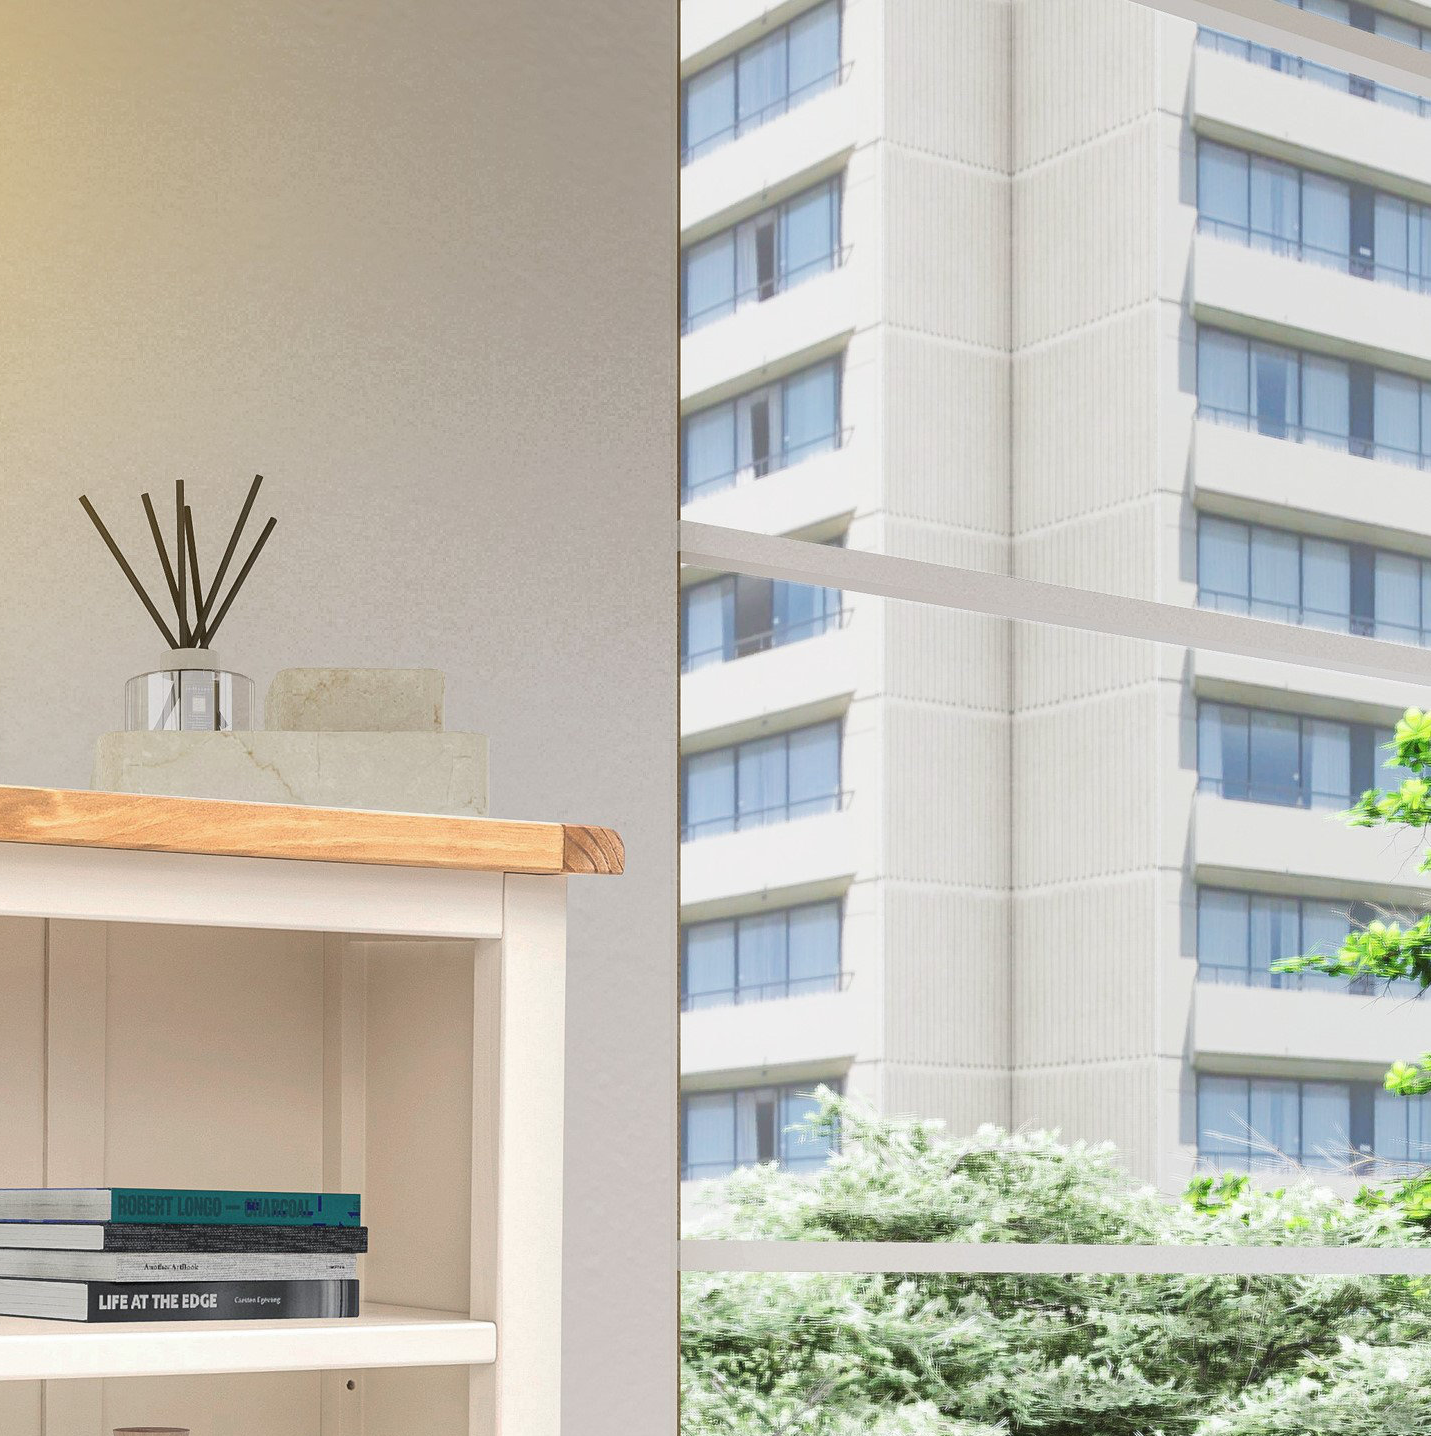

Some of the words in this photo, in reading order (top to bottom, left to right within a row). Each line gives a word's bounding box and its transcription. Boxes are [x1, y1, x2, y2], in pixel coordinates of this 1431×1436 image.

[118, 1195, 173, 1217] ROBERT
[178, 1196, 222, 1217] LONGO
[99, 1294, 128, 1310] LIFE
[131, 1294, 149, 1310] AT
[152, 1293, 179, 1309] THE
[182, 1293, 218, 1309] EDGE
